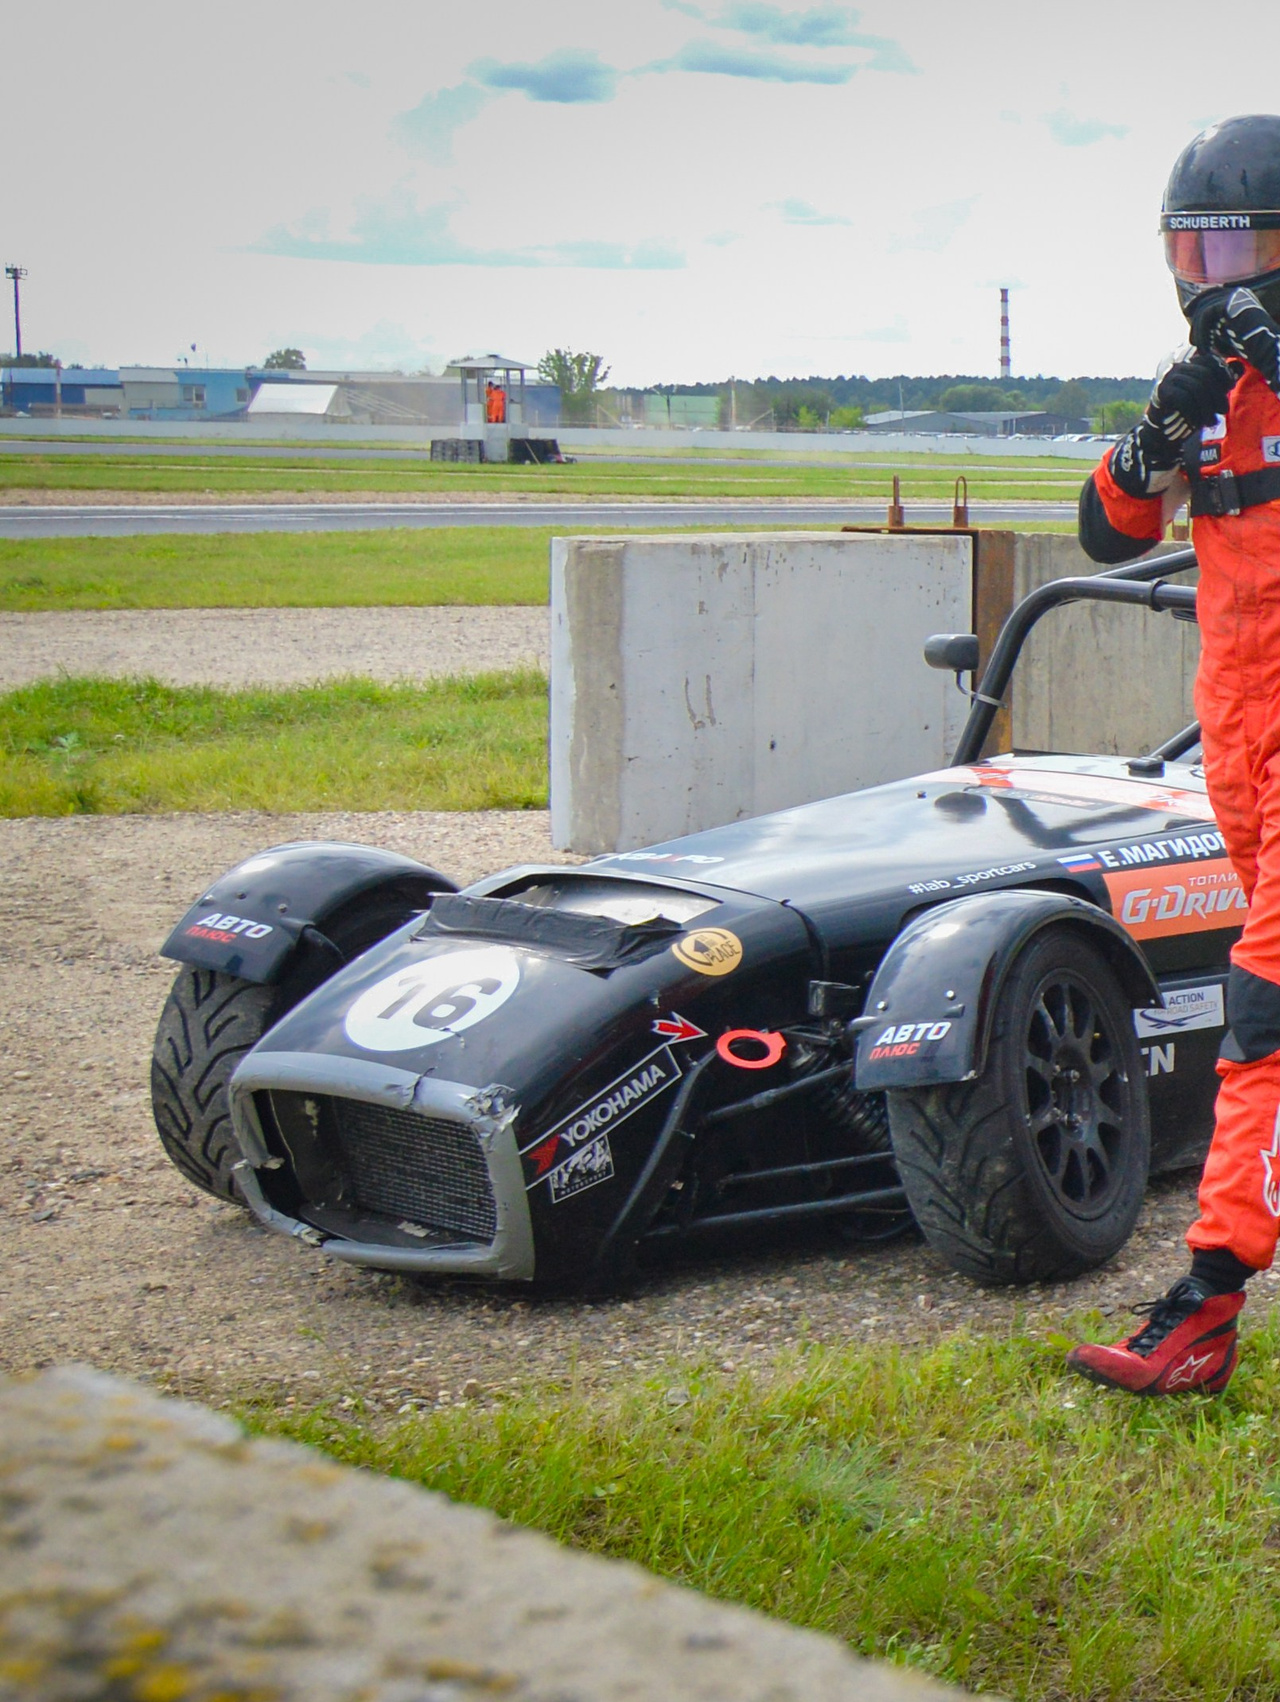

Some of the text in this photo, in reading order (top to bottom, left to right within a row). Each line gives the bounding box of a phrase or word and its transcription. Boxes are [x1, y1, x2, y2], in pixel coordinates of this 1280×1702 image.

[1170, 215, 1250, 229] SCHUBERTH
[908, 861, 1036, 895] #lab_sportcars
[184, 926, 237, 943] ПЛЮС
[196, 913, 274, 939] АВТО
[376, 974, 503, 1030] 16
[1168, 992, 1205, 1006] ACTION
[874, 1021, 952, 1046] АВТО
[869, 1042, 920, 1060] ПЛЮС
[560, 1064, 667, 1147] YOKOHAMA
